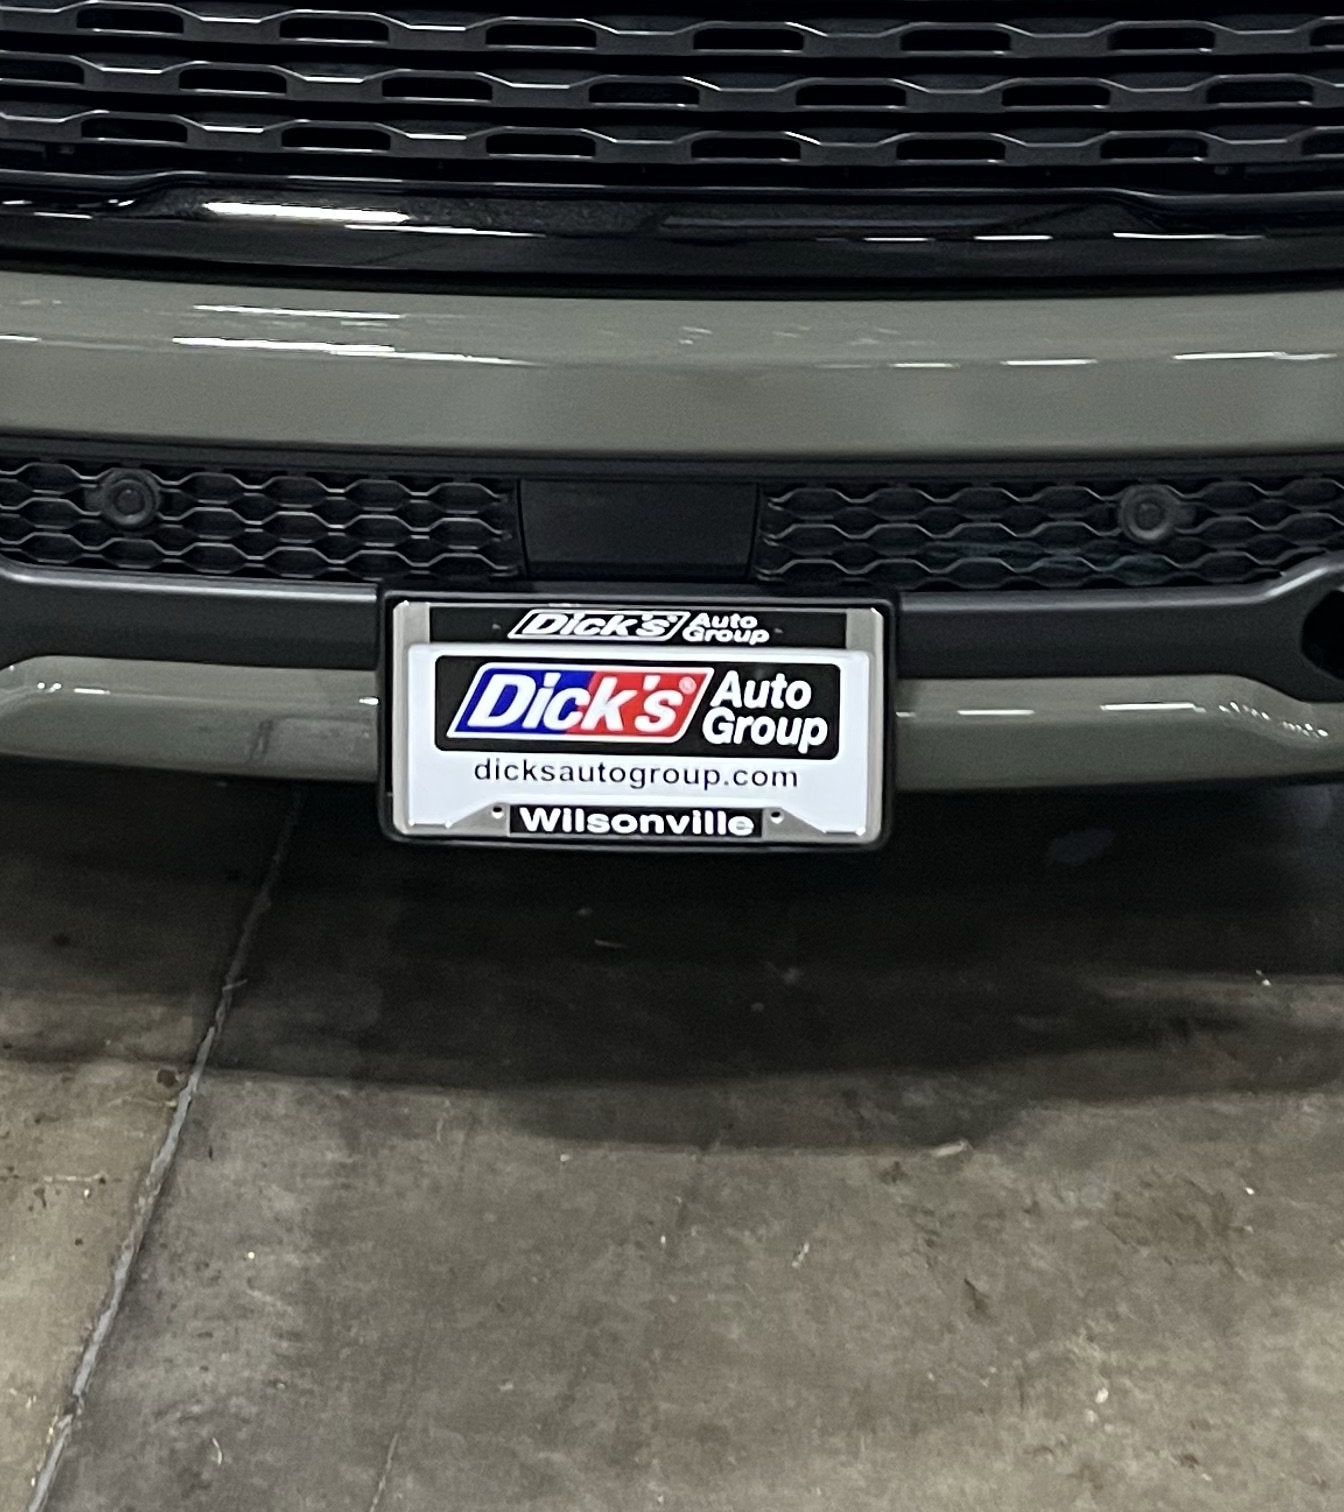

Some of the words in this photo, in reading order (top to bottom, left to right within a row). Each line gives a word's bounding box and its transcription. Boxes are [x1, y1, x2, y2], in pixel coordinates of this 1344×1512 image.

[682, 626, 770, 645] Group
[695, 611, 758, 630] Auto
[709, 670, 812, 710] Auto
[701, 707, 828, 754] Group
[474, 758, 798, 790] dicksautogroup.com
[518, 806, 755, 836] Wilsonville
